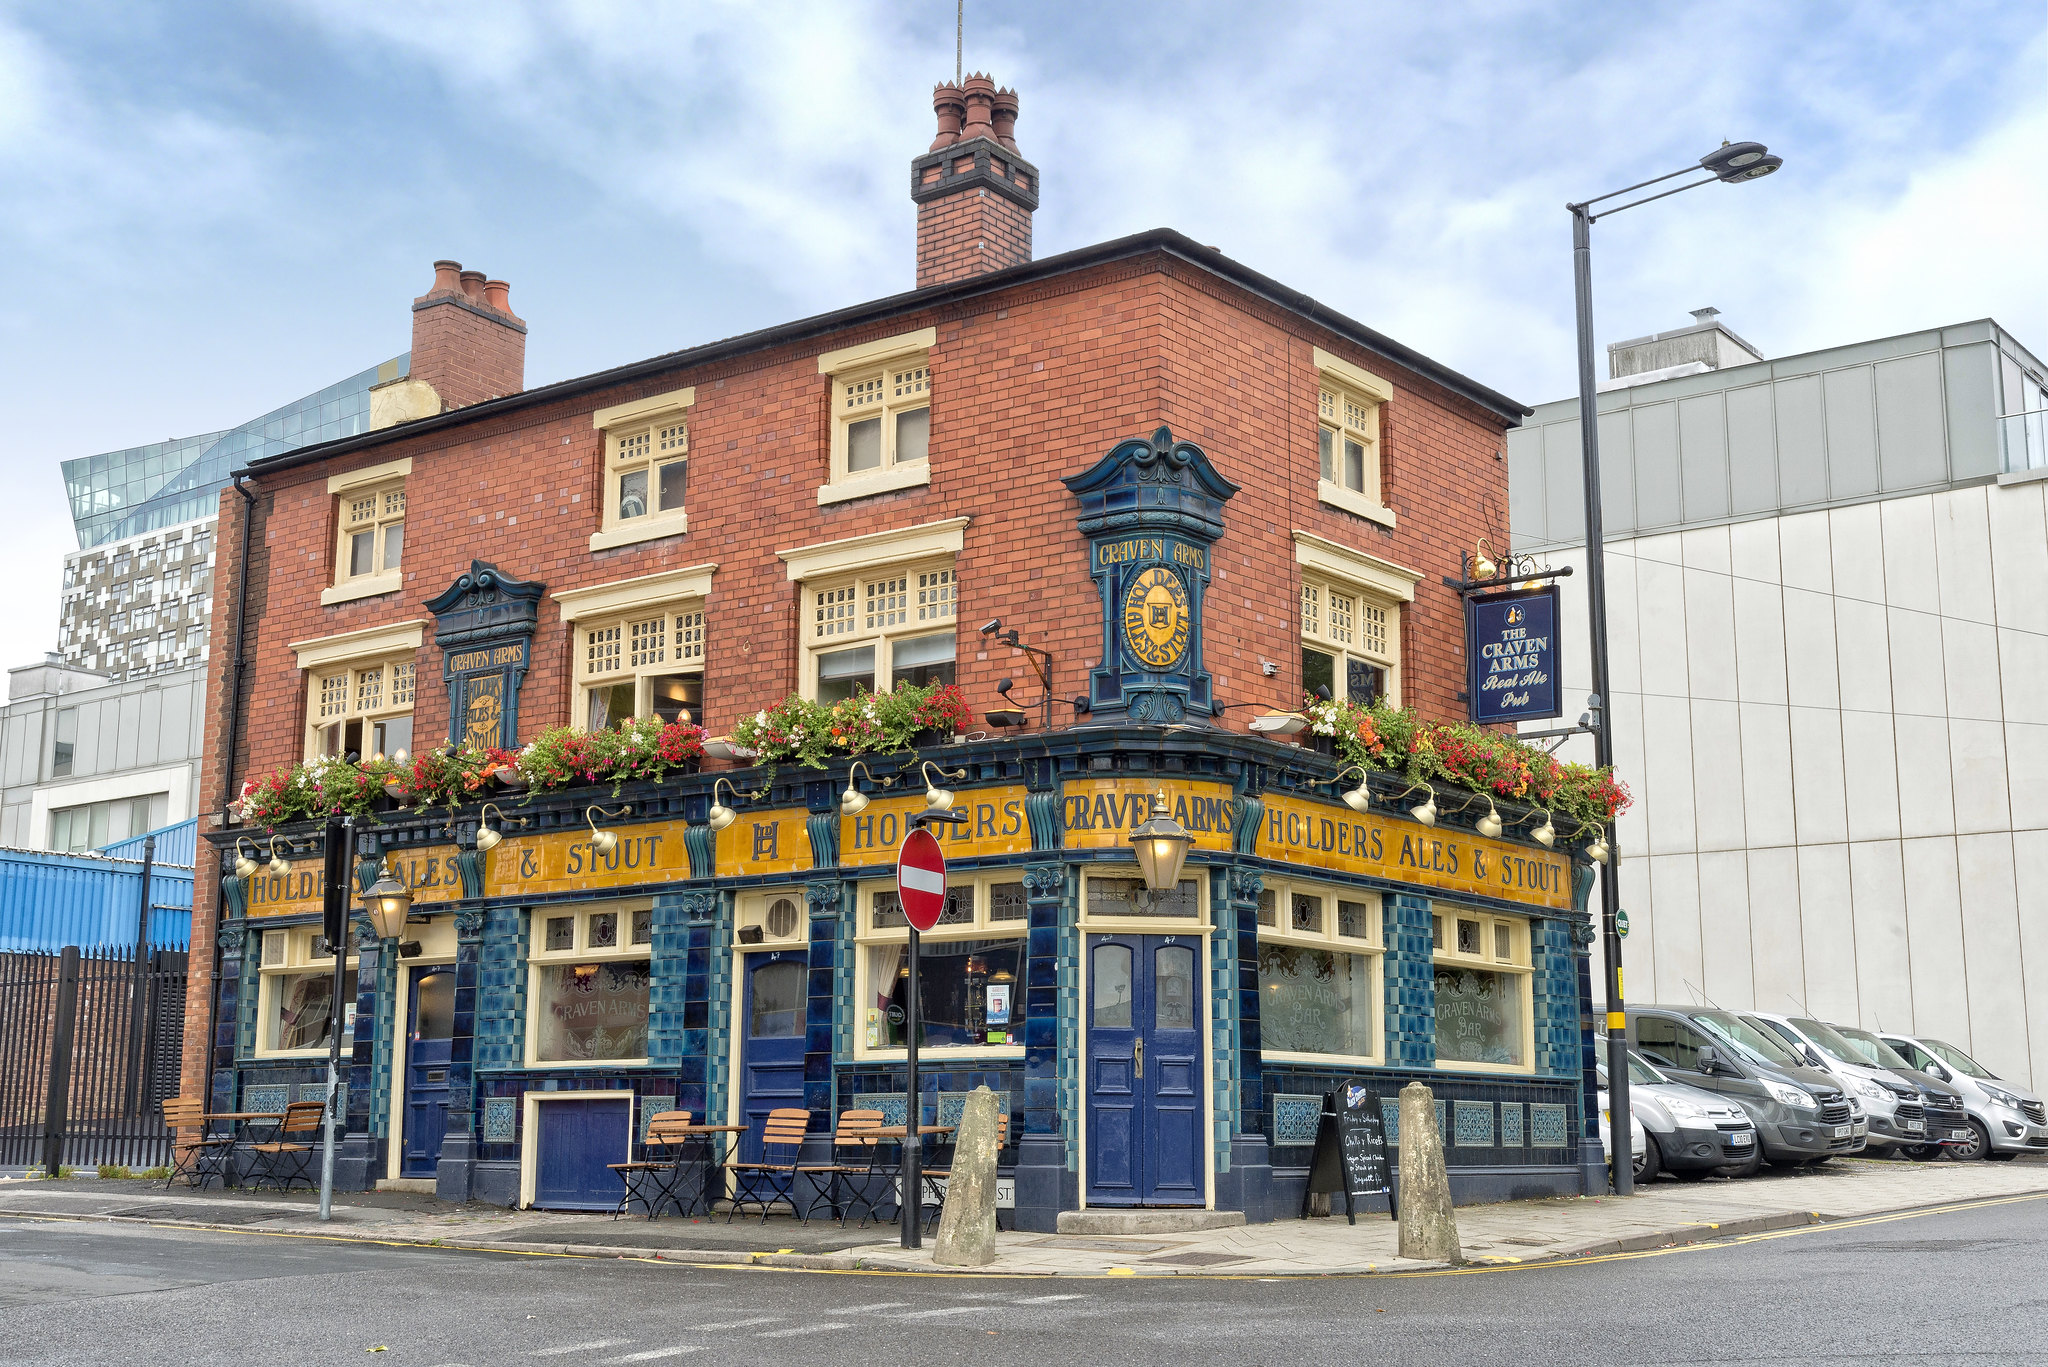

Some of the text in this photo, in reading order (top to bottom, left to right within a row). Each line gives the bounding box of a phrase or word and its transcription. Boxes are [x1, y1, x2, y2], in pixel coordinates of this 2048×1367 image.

[1100, 539, 1204, 570] CRAVEN ARMS
[1128, 569, 1188, 610] HOLDERS
[1127, 611, 1154, 655] ALES
[1159, 612, 1188, 663] STOUT
[1481, 636, 1548, 659] CRAVEN
[1501, 627, 1527, 641] THE
[450, 645, 523, 673] CRAVEN ARMS
[1488, 653, 1539, 674] ARMS
[1481, 670, 1548, 692] Real Ale
[1500, 691, 1530, 709] Pub
[467, 706, 490, 724] ALES
[466, 721, 500, 752] STOUT
[1173, 794, 1234, 835] ARMS
[520, 834, 663, 879] & STOUT
[1266, 807, 1563, 894] HOLDERS ALES & STOUT
[252, 856, 459, 904] HOLDES ALES
[554, 999, 646, 1021] CRAVEN ARMS
[1265, 984, 1347, 1012] CRAVEN ARMS
[1289, 1001, 1326, 1030] BAR
[1436, 1001, 1502, 1026] CRAVEN ARMS
[1456, 1016, 1486, 1042] BAR
